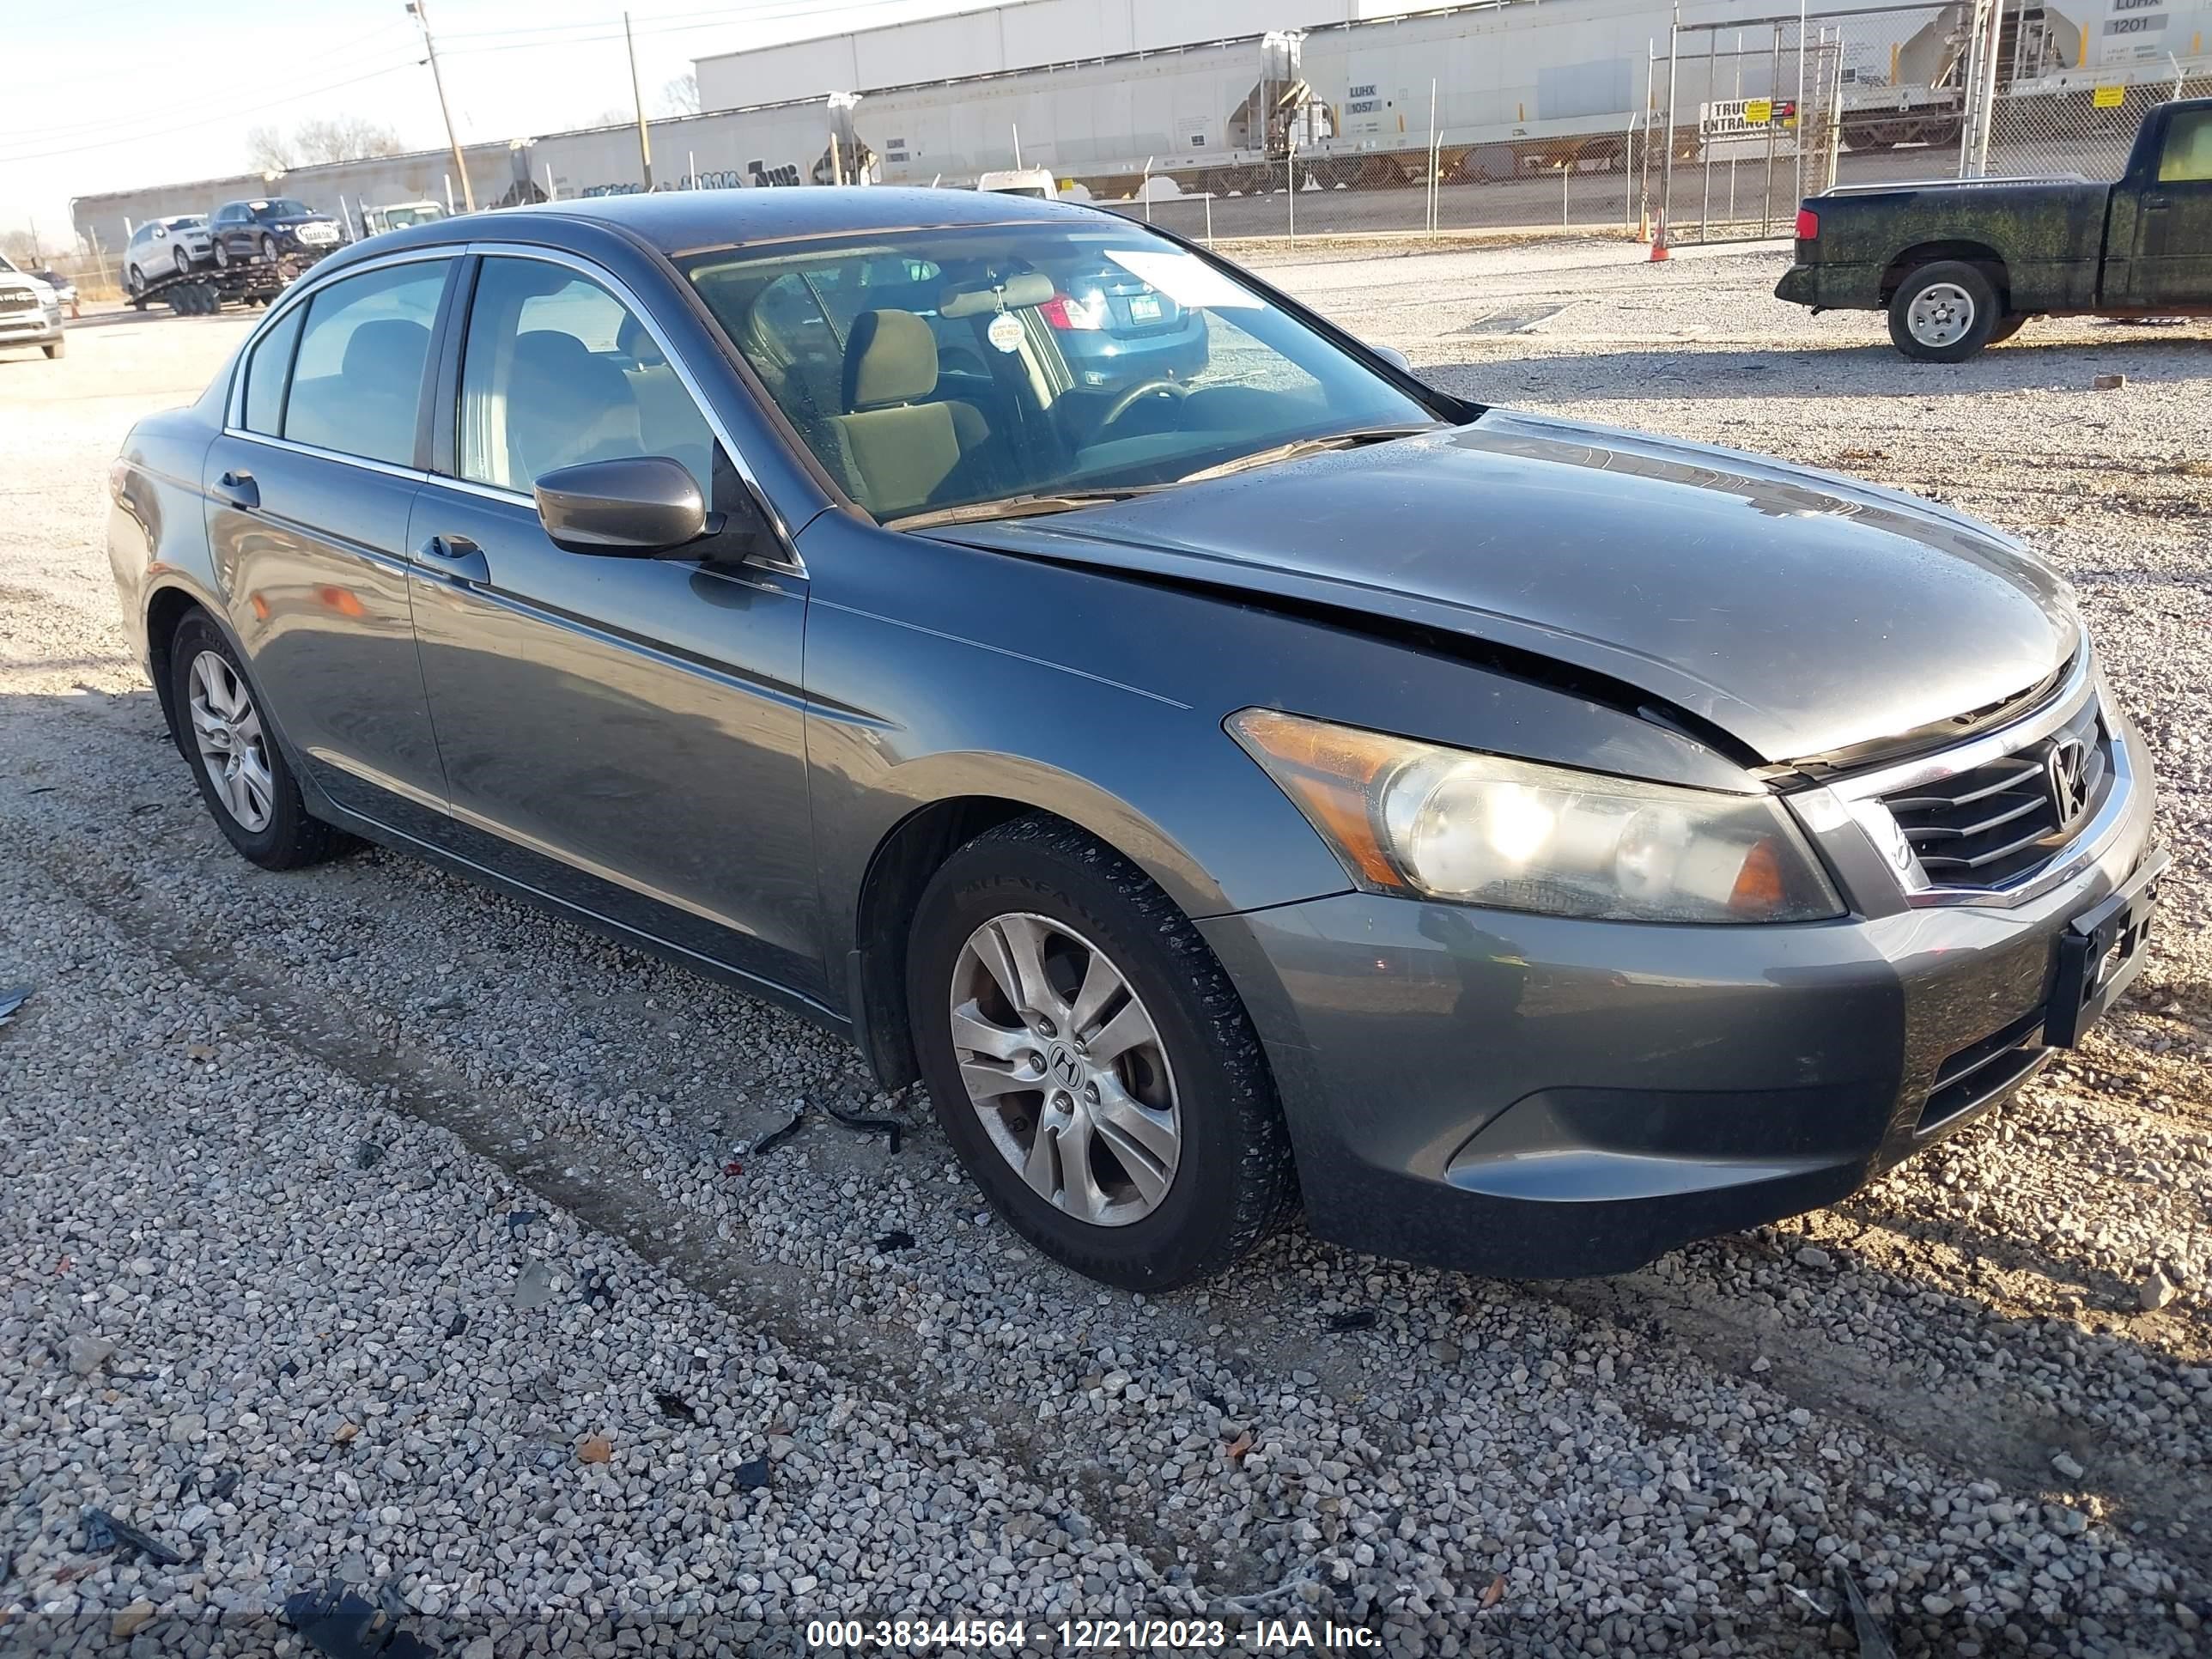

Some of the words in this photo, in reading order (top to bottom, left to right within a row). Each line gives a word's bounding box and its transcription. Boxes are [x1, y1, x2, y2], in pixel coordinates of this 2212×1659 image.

[2113, 17, 2148, 33] 1201
[1350, 85, 1376, 98] LUHX
[1352, 101, 1373, 113] 1057
[1715, 100, 1760, 116] TRUC
